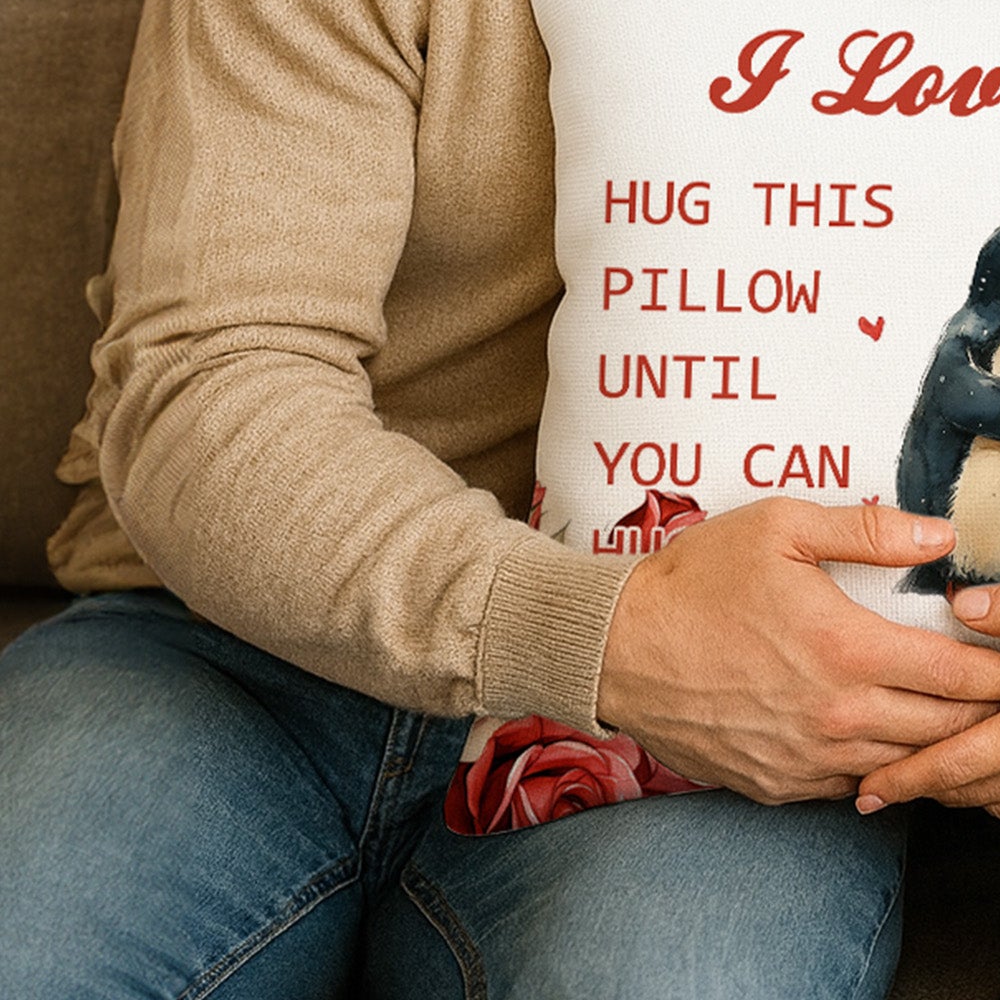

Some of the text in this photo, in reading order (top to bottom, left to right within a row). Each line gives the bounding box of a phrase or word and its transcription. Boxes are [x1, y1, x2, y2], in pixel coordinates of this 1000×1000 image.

[709, 29, 804, 114] I
[604, 180, 894, 228] HUG THIS
[603, 267, 821, 314] PILLOW
[598, 354, 777, 400] UNTIL
[593, 441, 851, 489] YOU CAN
